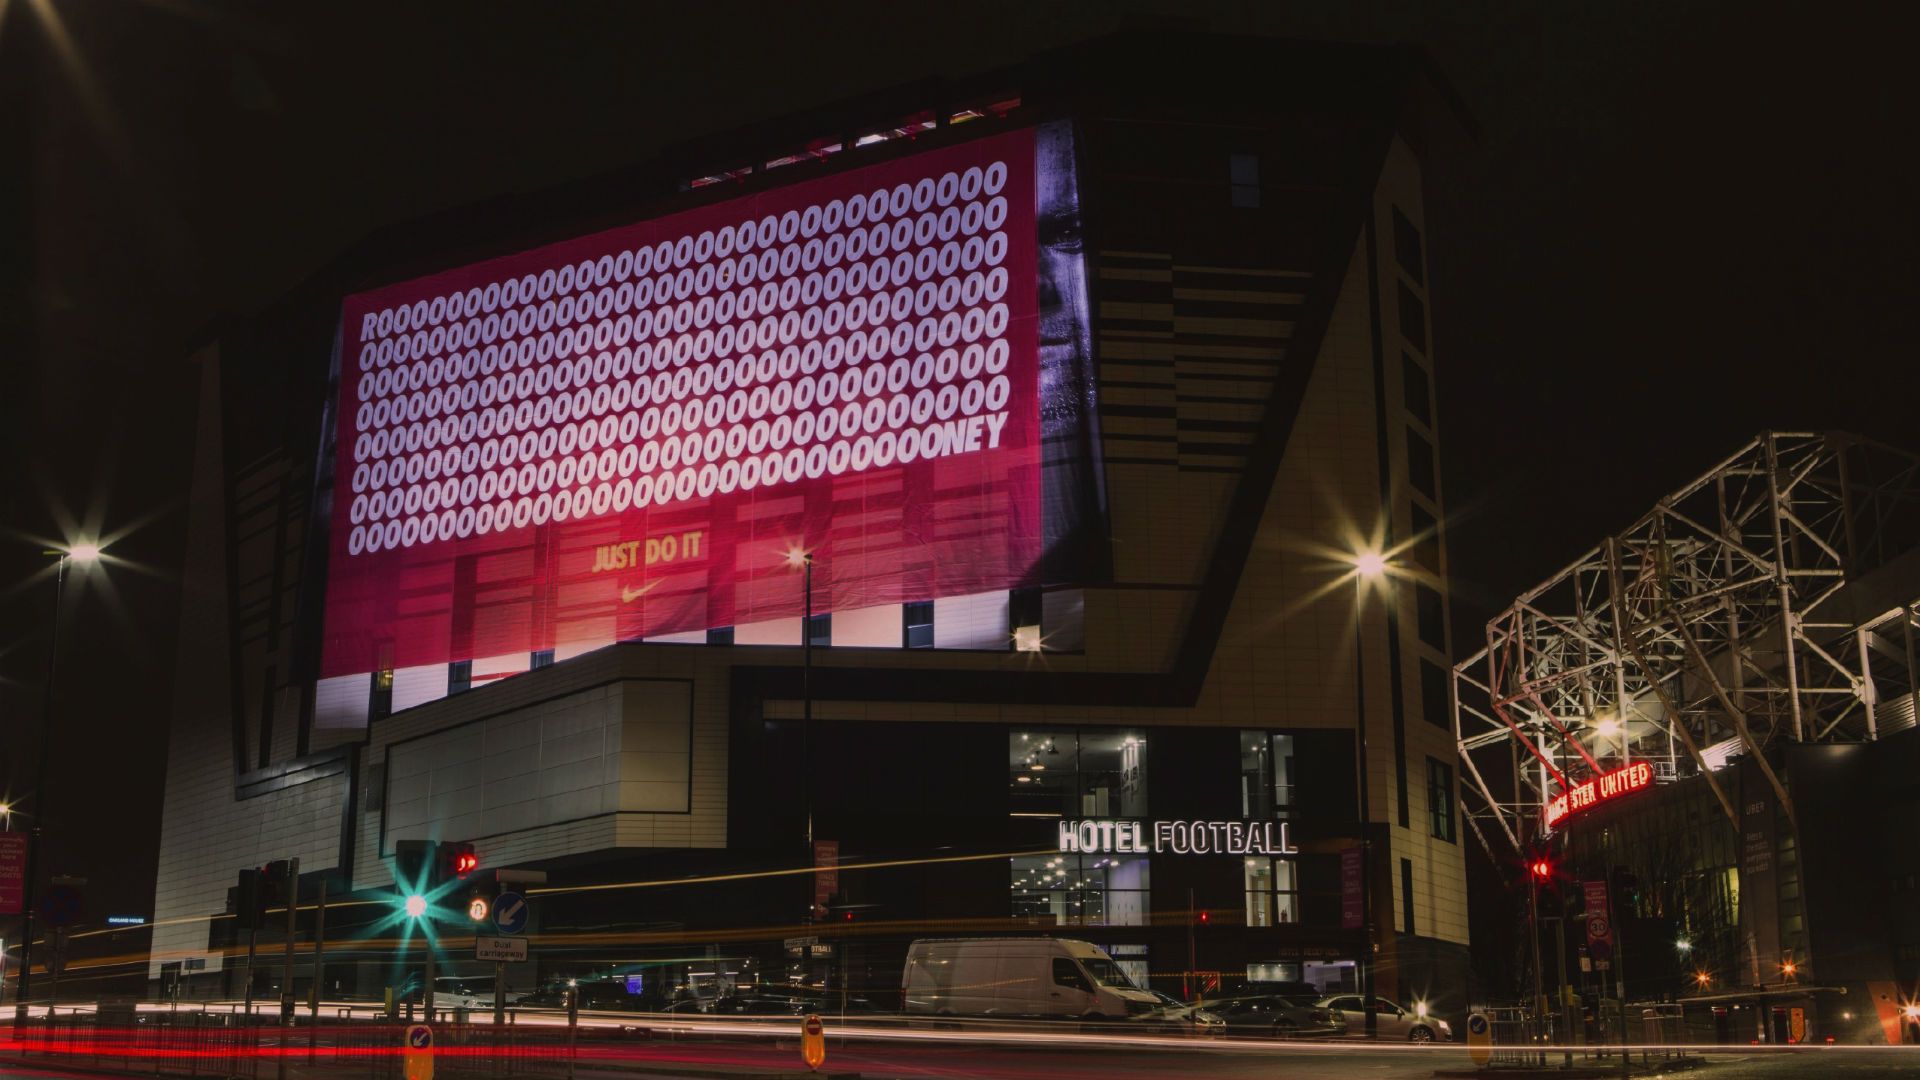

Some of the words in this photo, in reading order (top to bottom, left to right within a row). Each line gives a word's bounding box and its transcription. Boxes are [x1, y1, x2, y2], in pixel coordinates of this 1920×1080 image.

[591, 540, 641, 574] JUST
[645, 534, 678, 565] DO
[682, 530, 703, 560] IT
[1600, 763, 1648, 798] UNITED
[1058, 819, 1150, 854] HOTEL
[1153, 820, 1299, 854] FOOTBALL
[1591, 923, 1605, 931] 30
[480, 950, 524, 959] carriageway
[494, 941, 512, 949] Dual
